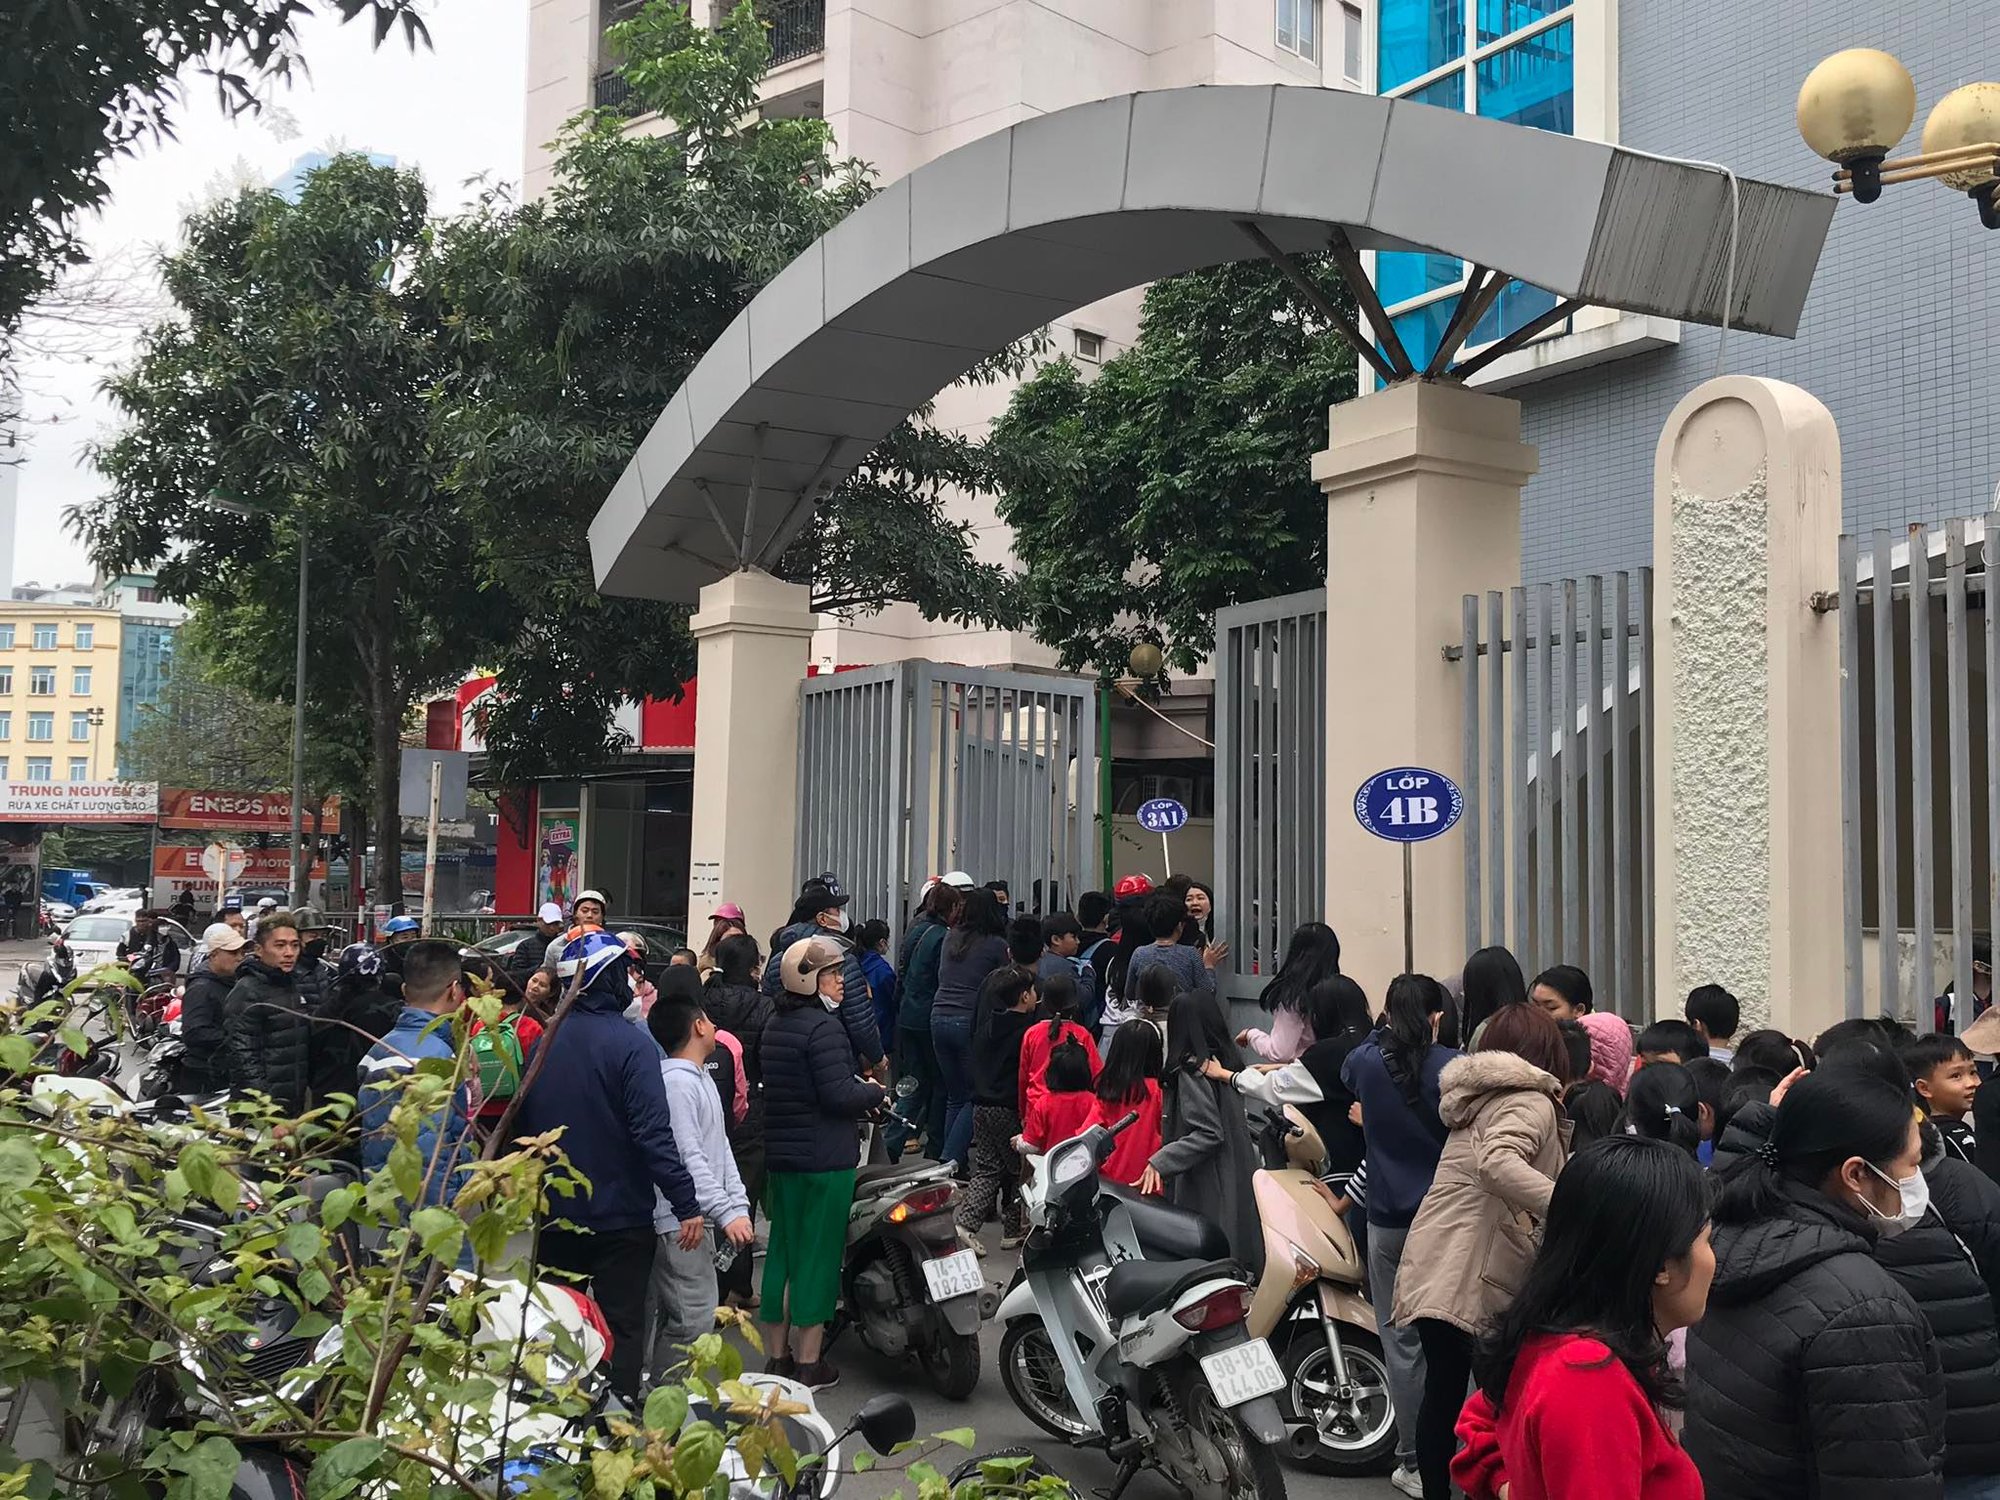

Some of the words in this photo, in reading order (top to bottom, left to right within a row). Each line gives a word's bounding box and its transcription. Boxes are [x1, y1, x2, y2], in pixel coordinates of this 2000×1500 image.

[8, 785, 63, 797] TRUNG
[34, 801, 48, 811] XE
[189, 796, 264, 815] ENEOS
[1379, 796, 1439, 825] 4B
[1147, 810, 1178, 827] 3A1
[932, 1254, 970, 1278] 14-Y1
[933, 1271, 981, 1298] 182.59
[1211, 1345, 1266, 1379] 98-B2
[1216, 1365, 1280, 1403] 144.09
